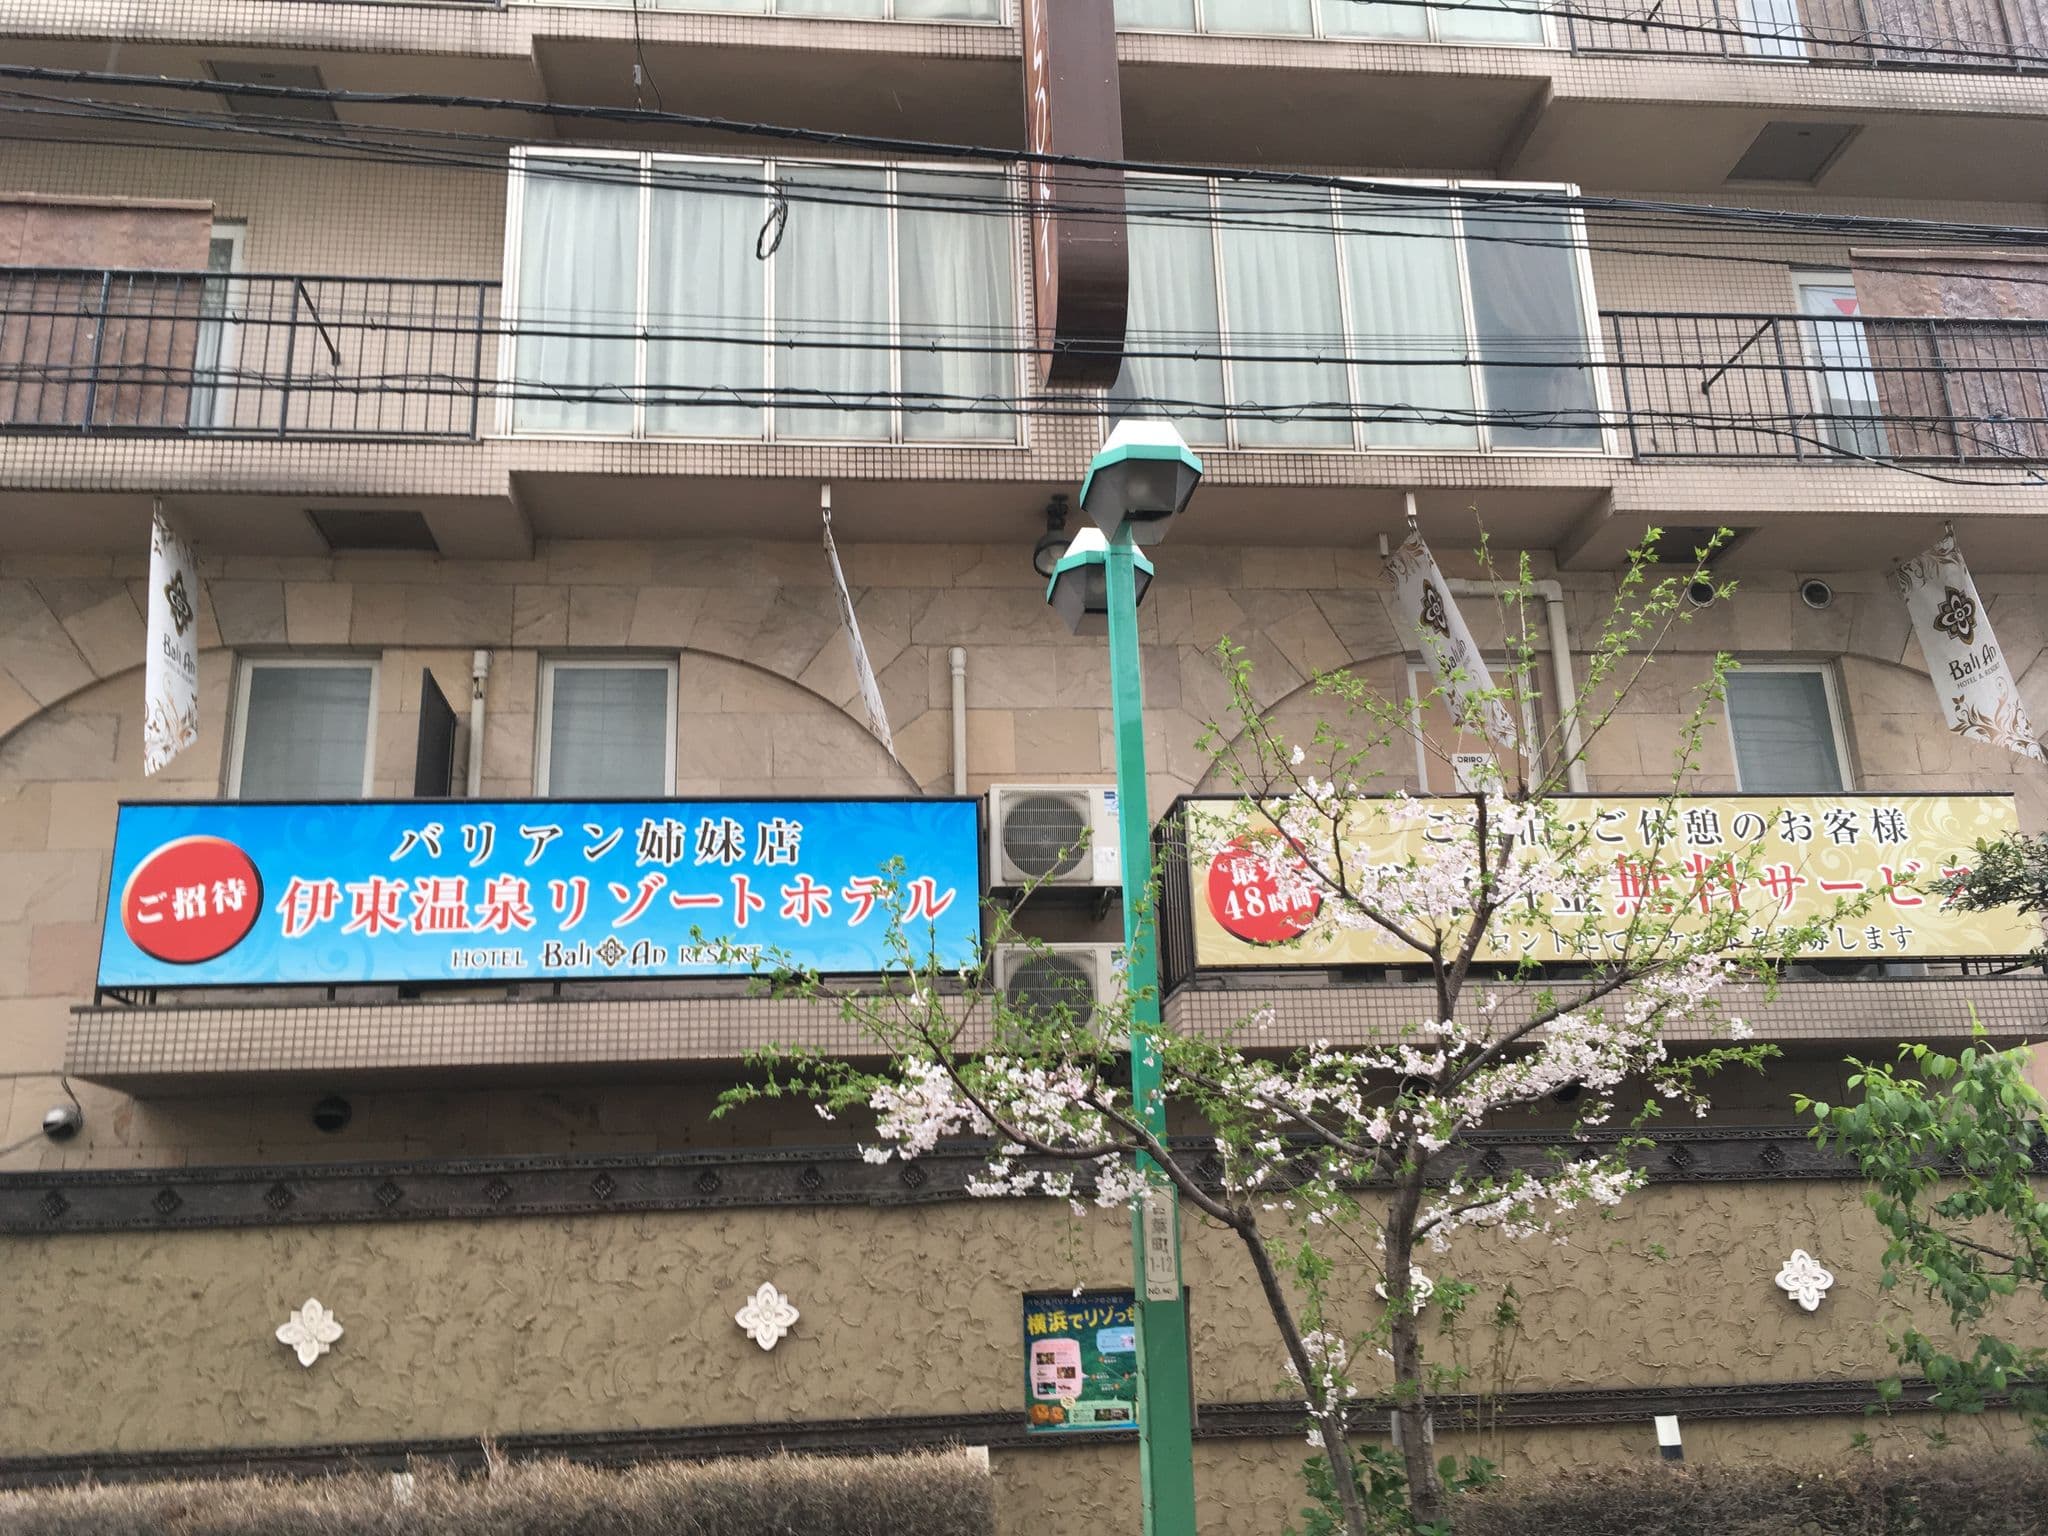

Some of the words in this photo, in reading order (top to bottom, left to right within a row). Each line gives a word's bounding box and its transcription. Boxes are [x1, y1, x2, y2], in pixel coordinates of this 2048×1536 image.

[1948, 652, 1981, 681] Bali
[1982, 643, 1997, 666] An
[1957, 677, 1977, 688] HOTEL
[391, 819, 803, 868] バリアン姉妹店
[136, 876, 248, 924] ご招待
[278, 872, 957, 936] 伊東温泉リゾートホテル
[452, 949, 525, 968] HOTEL
[543, 941, 591, 968] Bali
[631, 940, 668, 966] An
[681, 943, 763, 964] RESORT
